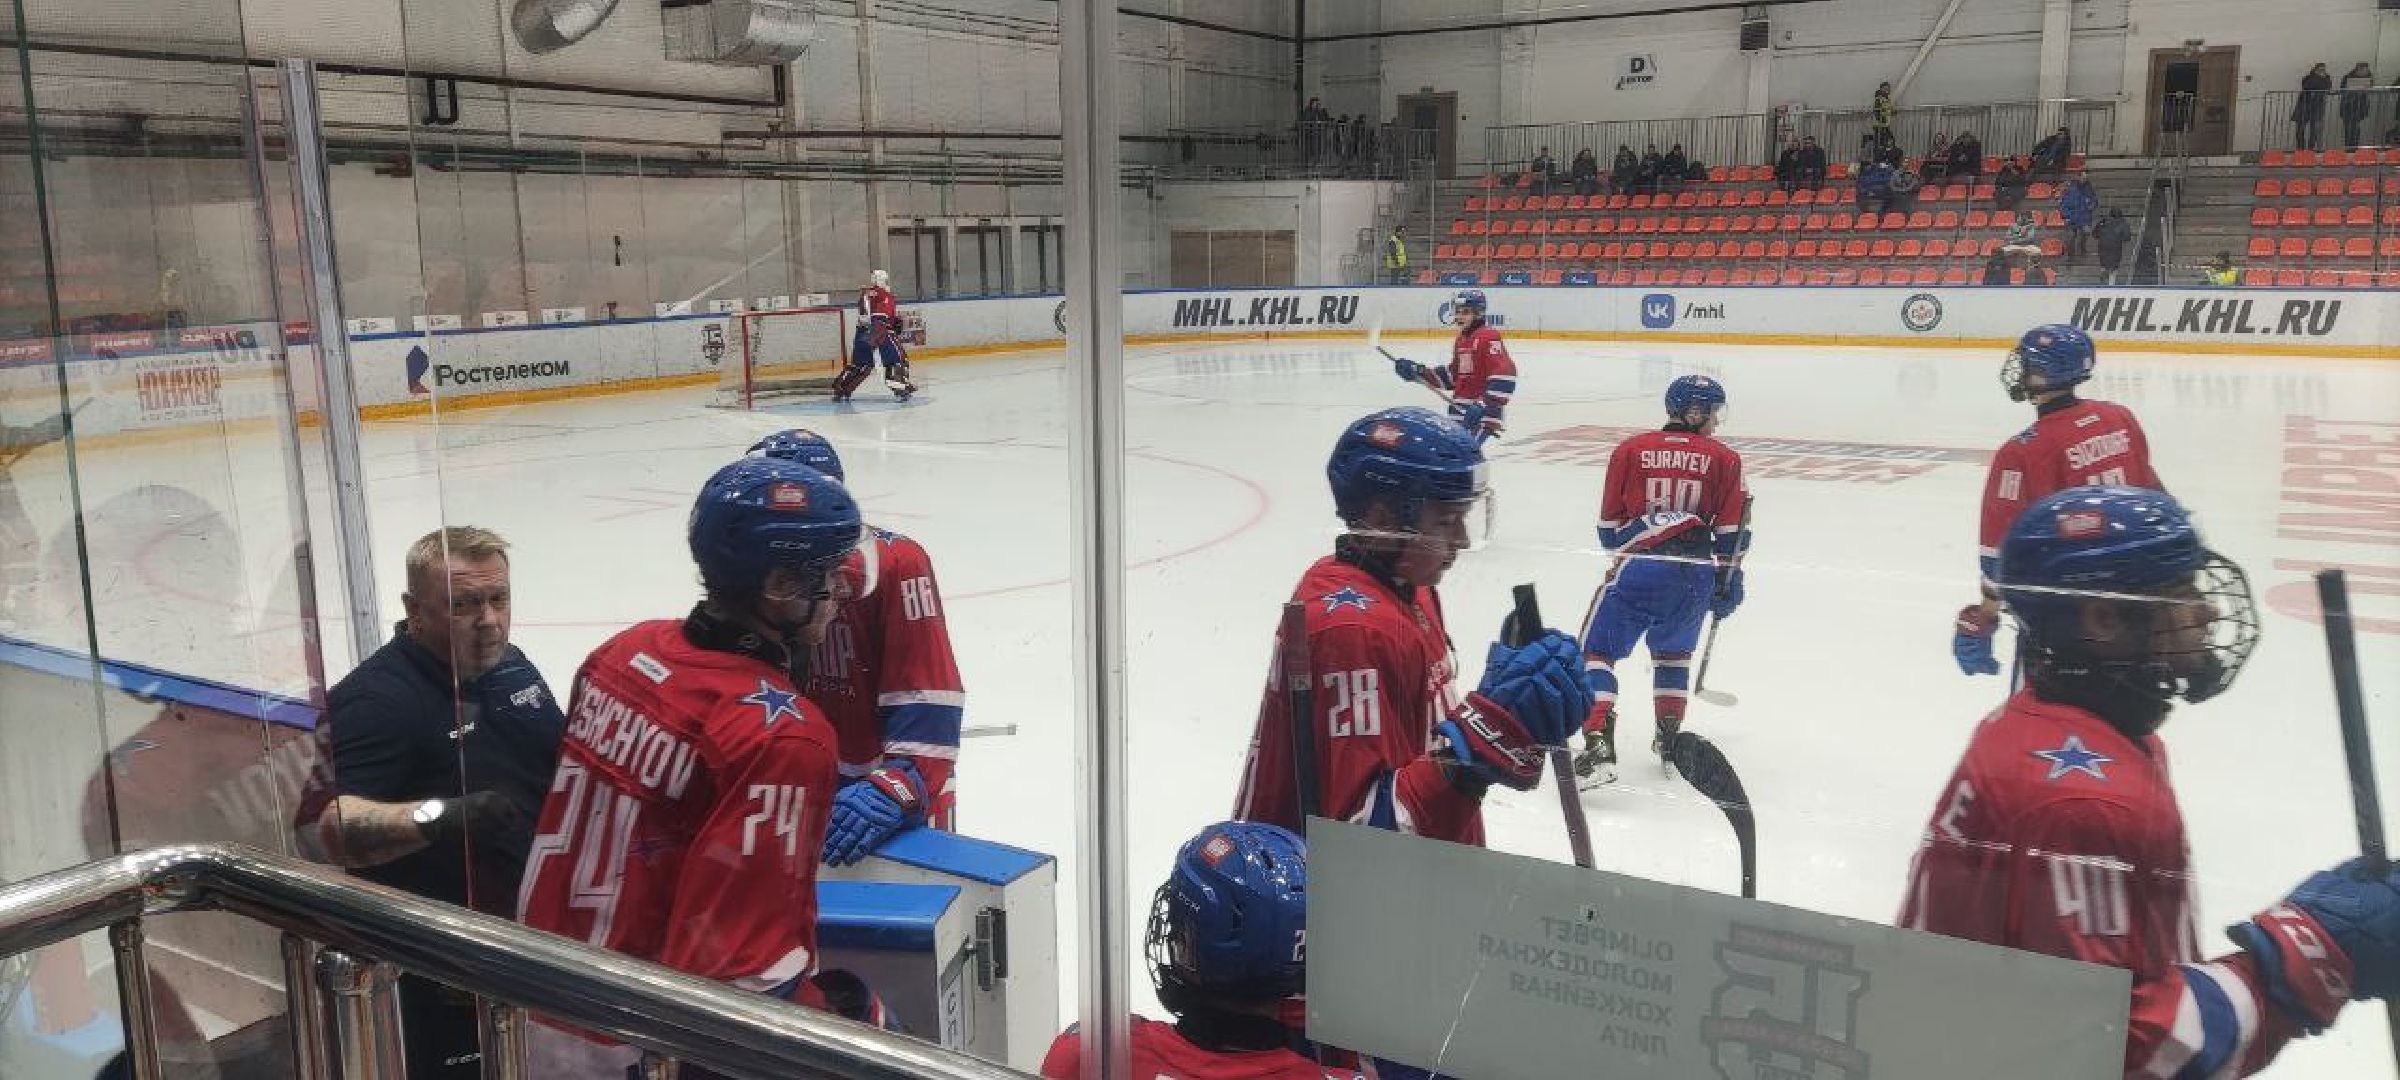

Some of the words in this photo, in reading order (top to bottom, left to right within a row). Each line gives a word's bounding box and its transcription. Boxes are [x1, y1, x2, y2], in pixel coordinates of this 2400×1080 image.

[1173, 296, 1359, 327] MHL.KHL.RU
[2070, 297, 2341, 335] MHL.KHL.RU
[433, 361, 569, 386] Ростелеком
[1641, 450, 1711, 475] SURAYEV
[1322, 668, 1381, 737] 28
[742, 784, 805, 855] 24
[517, 754, 641, 947] 24
[2050, 856, 2130, 936] 40
